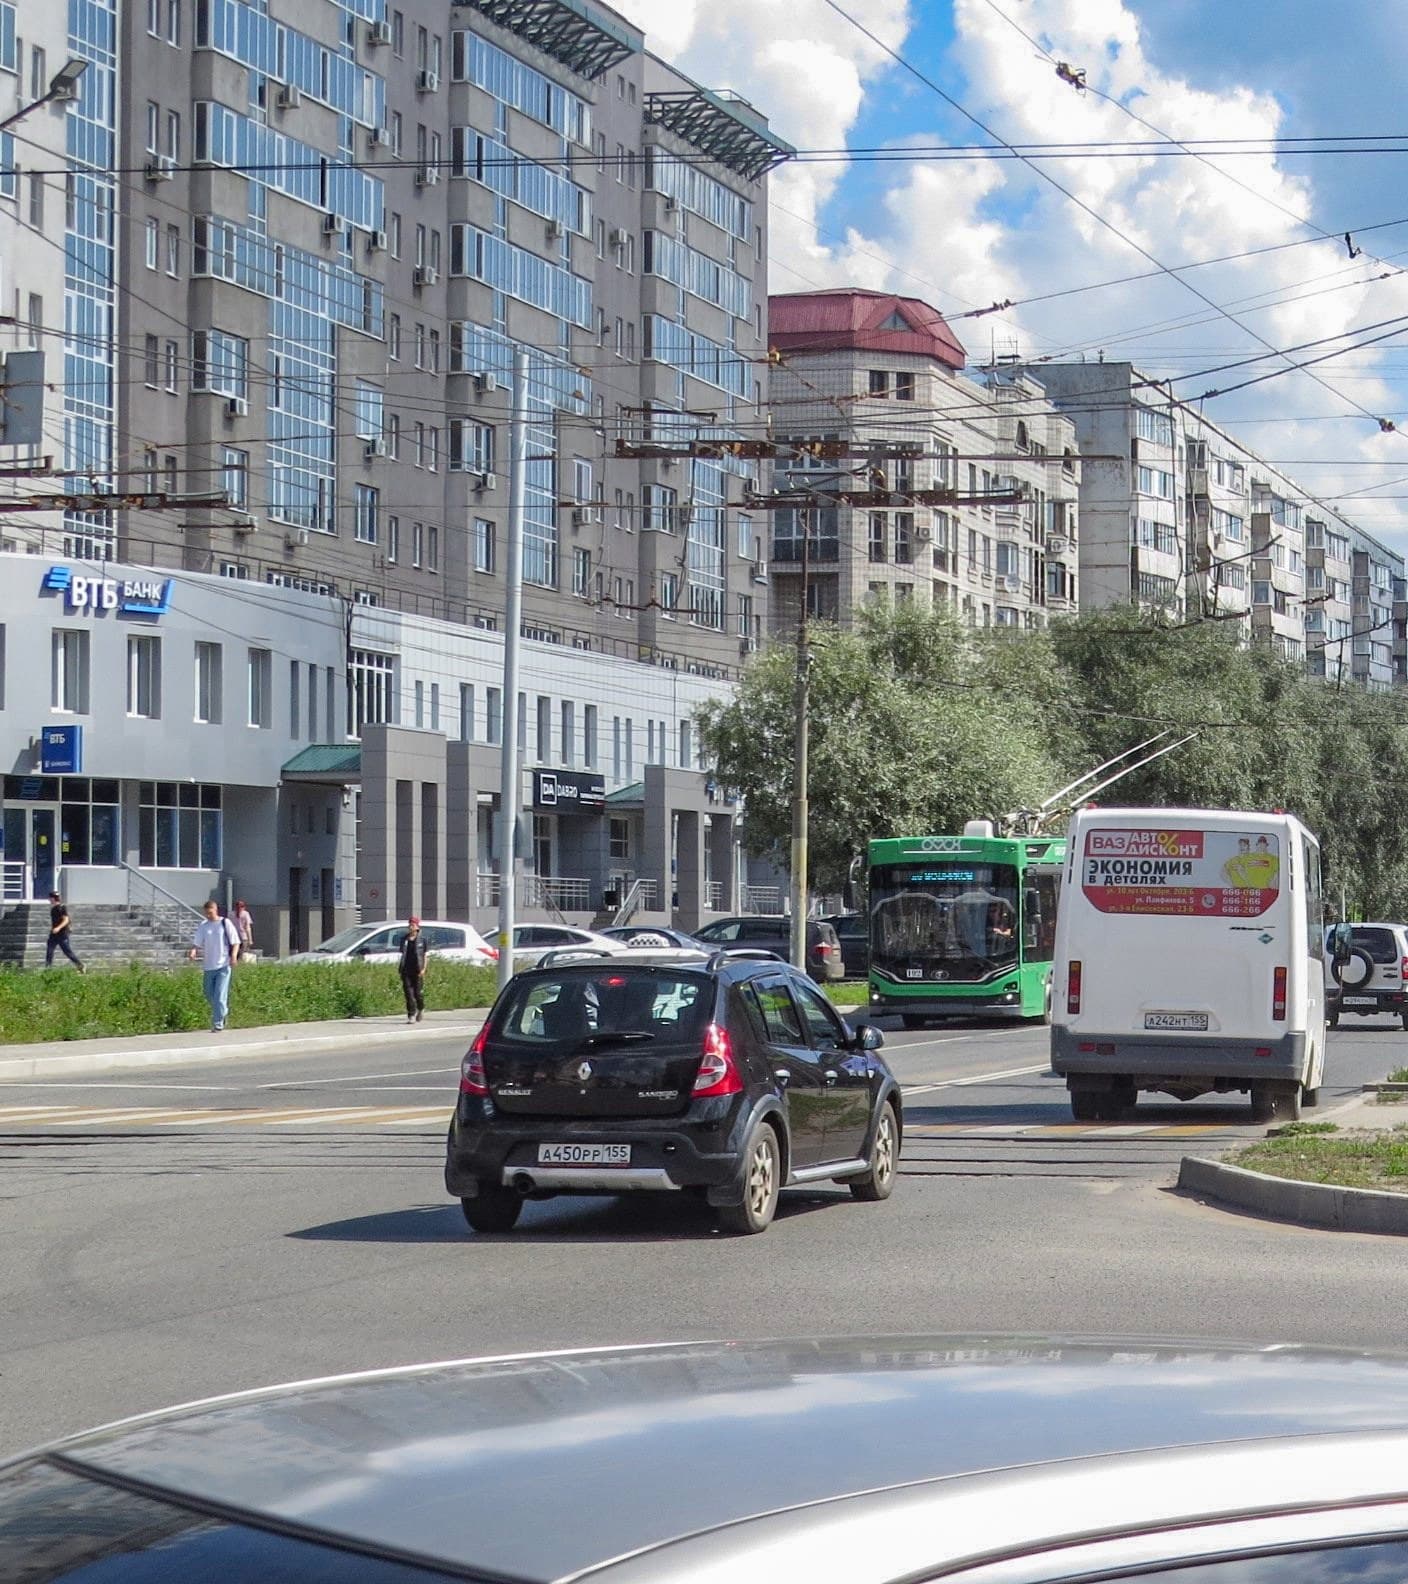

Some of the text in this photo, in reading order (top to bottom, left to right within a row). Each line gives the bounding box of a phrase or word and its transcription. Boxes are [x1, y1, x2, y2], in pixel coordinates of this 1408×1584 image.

[71, 576, 162, 609] ВТБ БАНК
[1092, 837, 1125, 849] ВАЗ
[1126, 844, 1198, 856] ДИСКОНТ
[1089, 860, 1192, 875] ЭКОНОМИЯ
[1089, 875, 1166, 886] в деталях
[543, 1146, 627, 1162] А450РР 155
